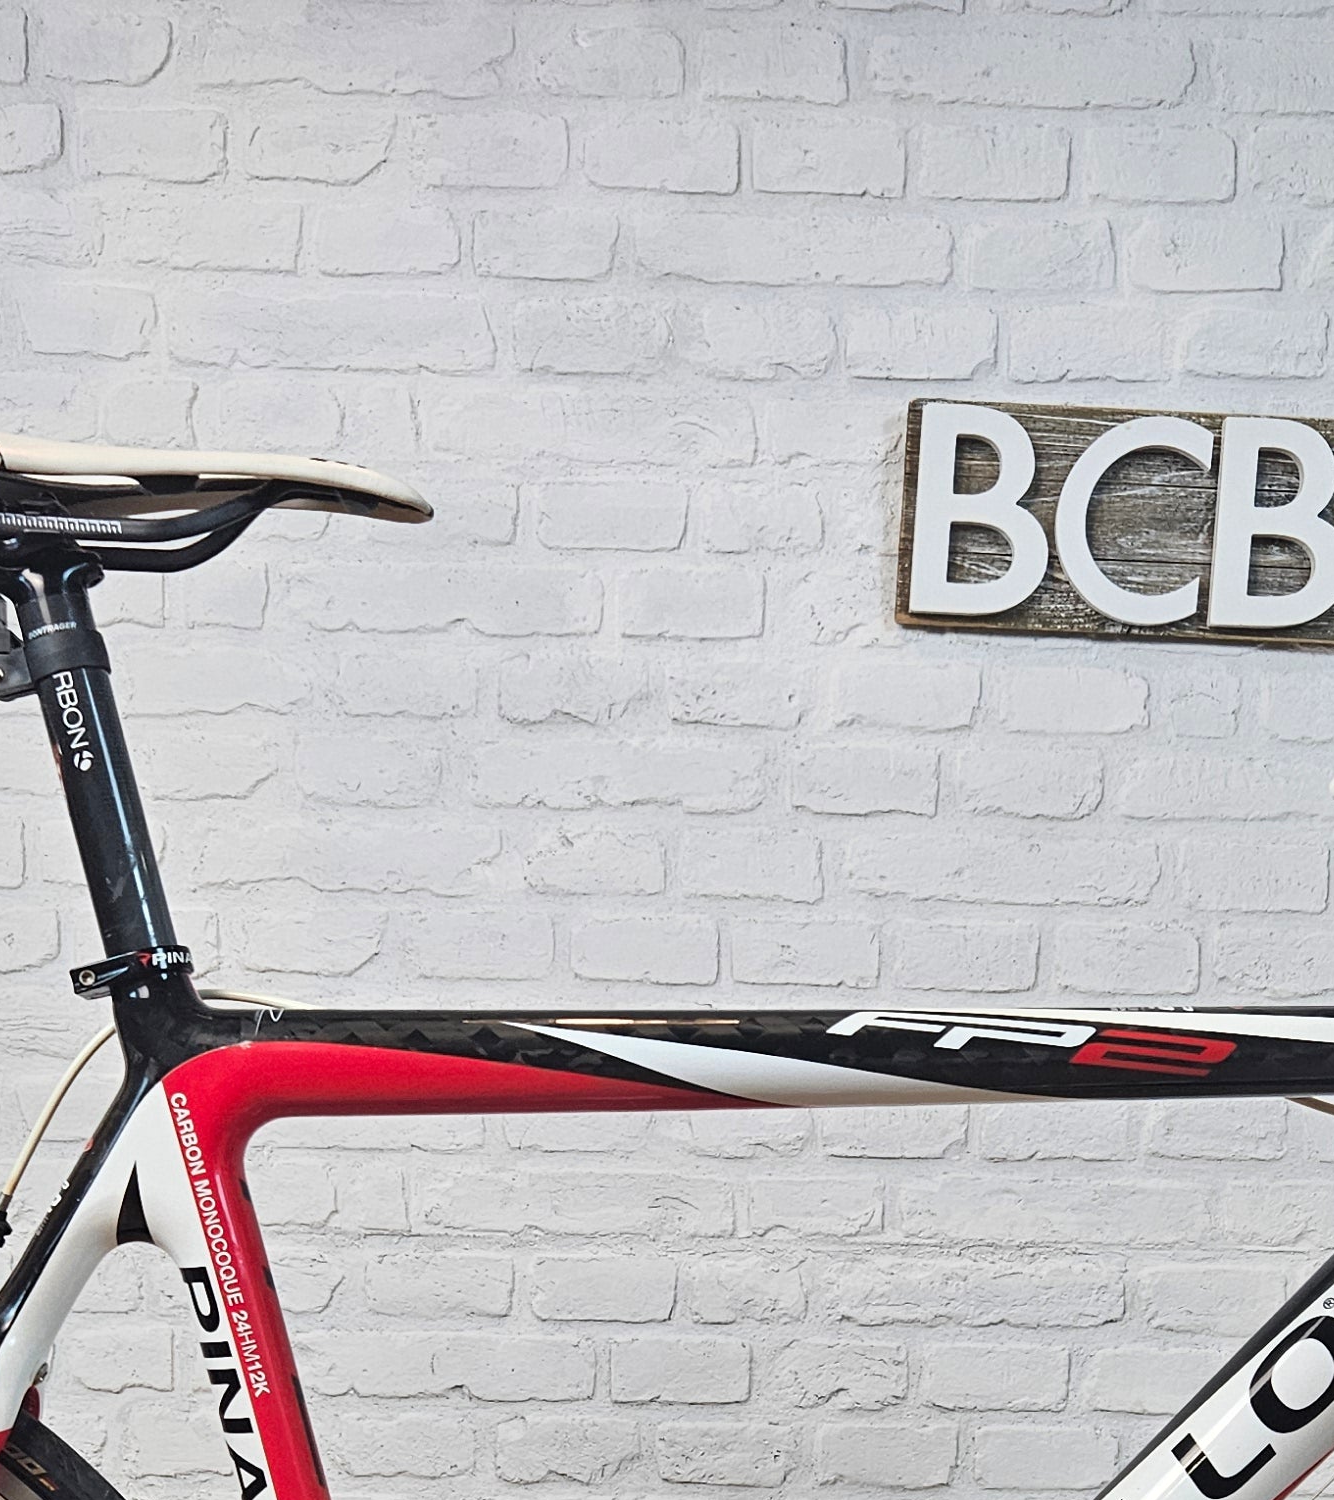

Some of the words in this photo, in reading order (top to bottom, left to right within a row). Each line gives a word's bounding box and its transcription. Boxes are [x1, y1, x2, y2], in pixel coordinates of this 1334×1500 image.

[825, 1011, 1237, 1077] FP2
[170, 1091, 206, 1176] CARBON
[194, 1178, 244, 1307] MONOCOQUE
[232, 1308, 271, 1398] 24HM12K
